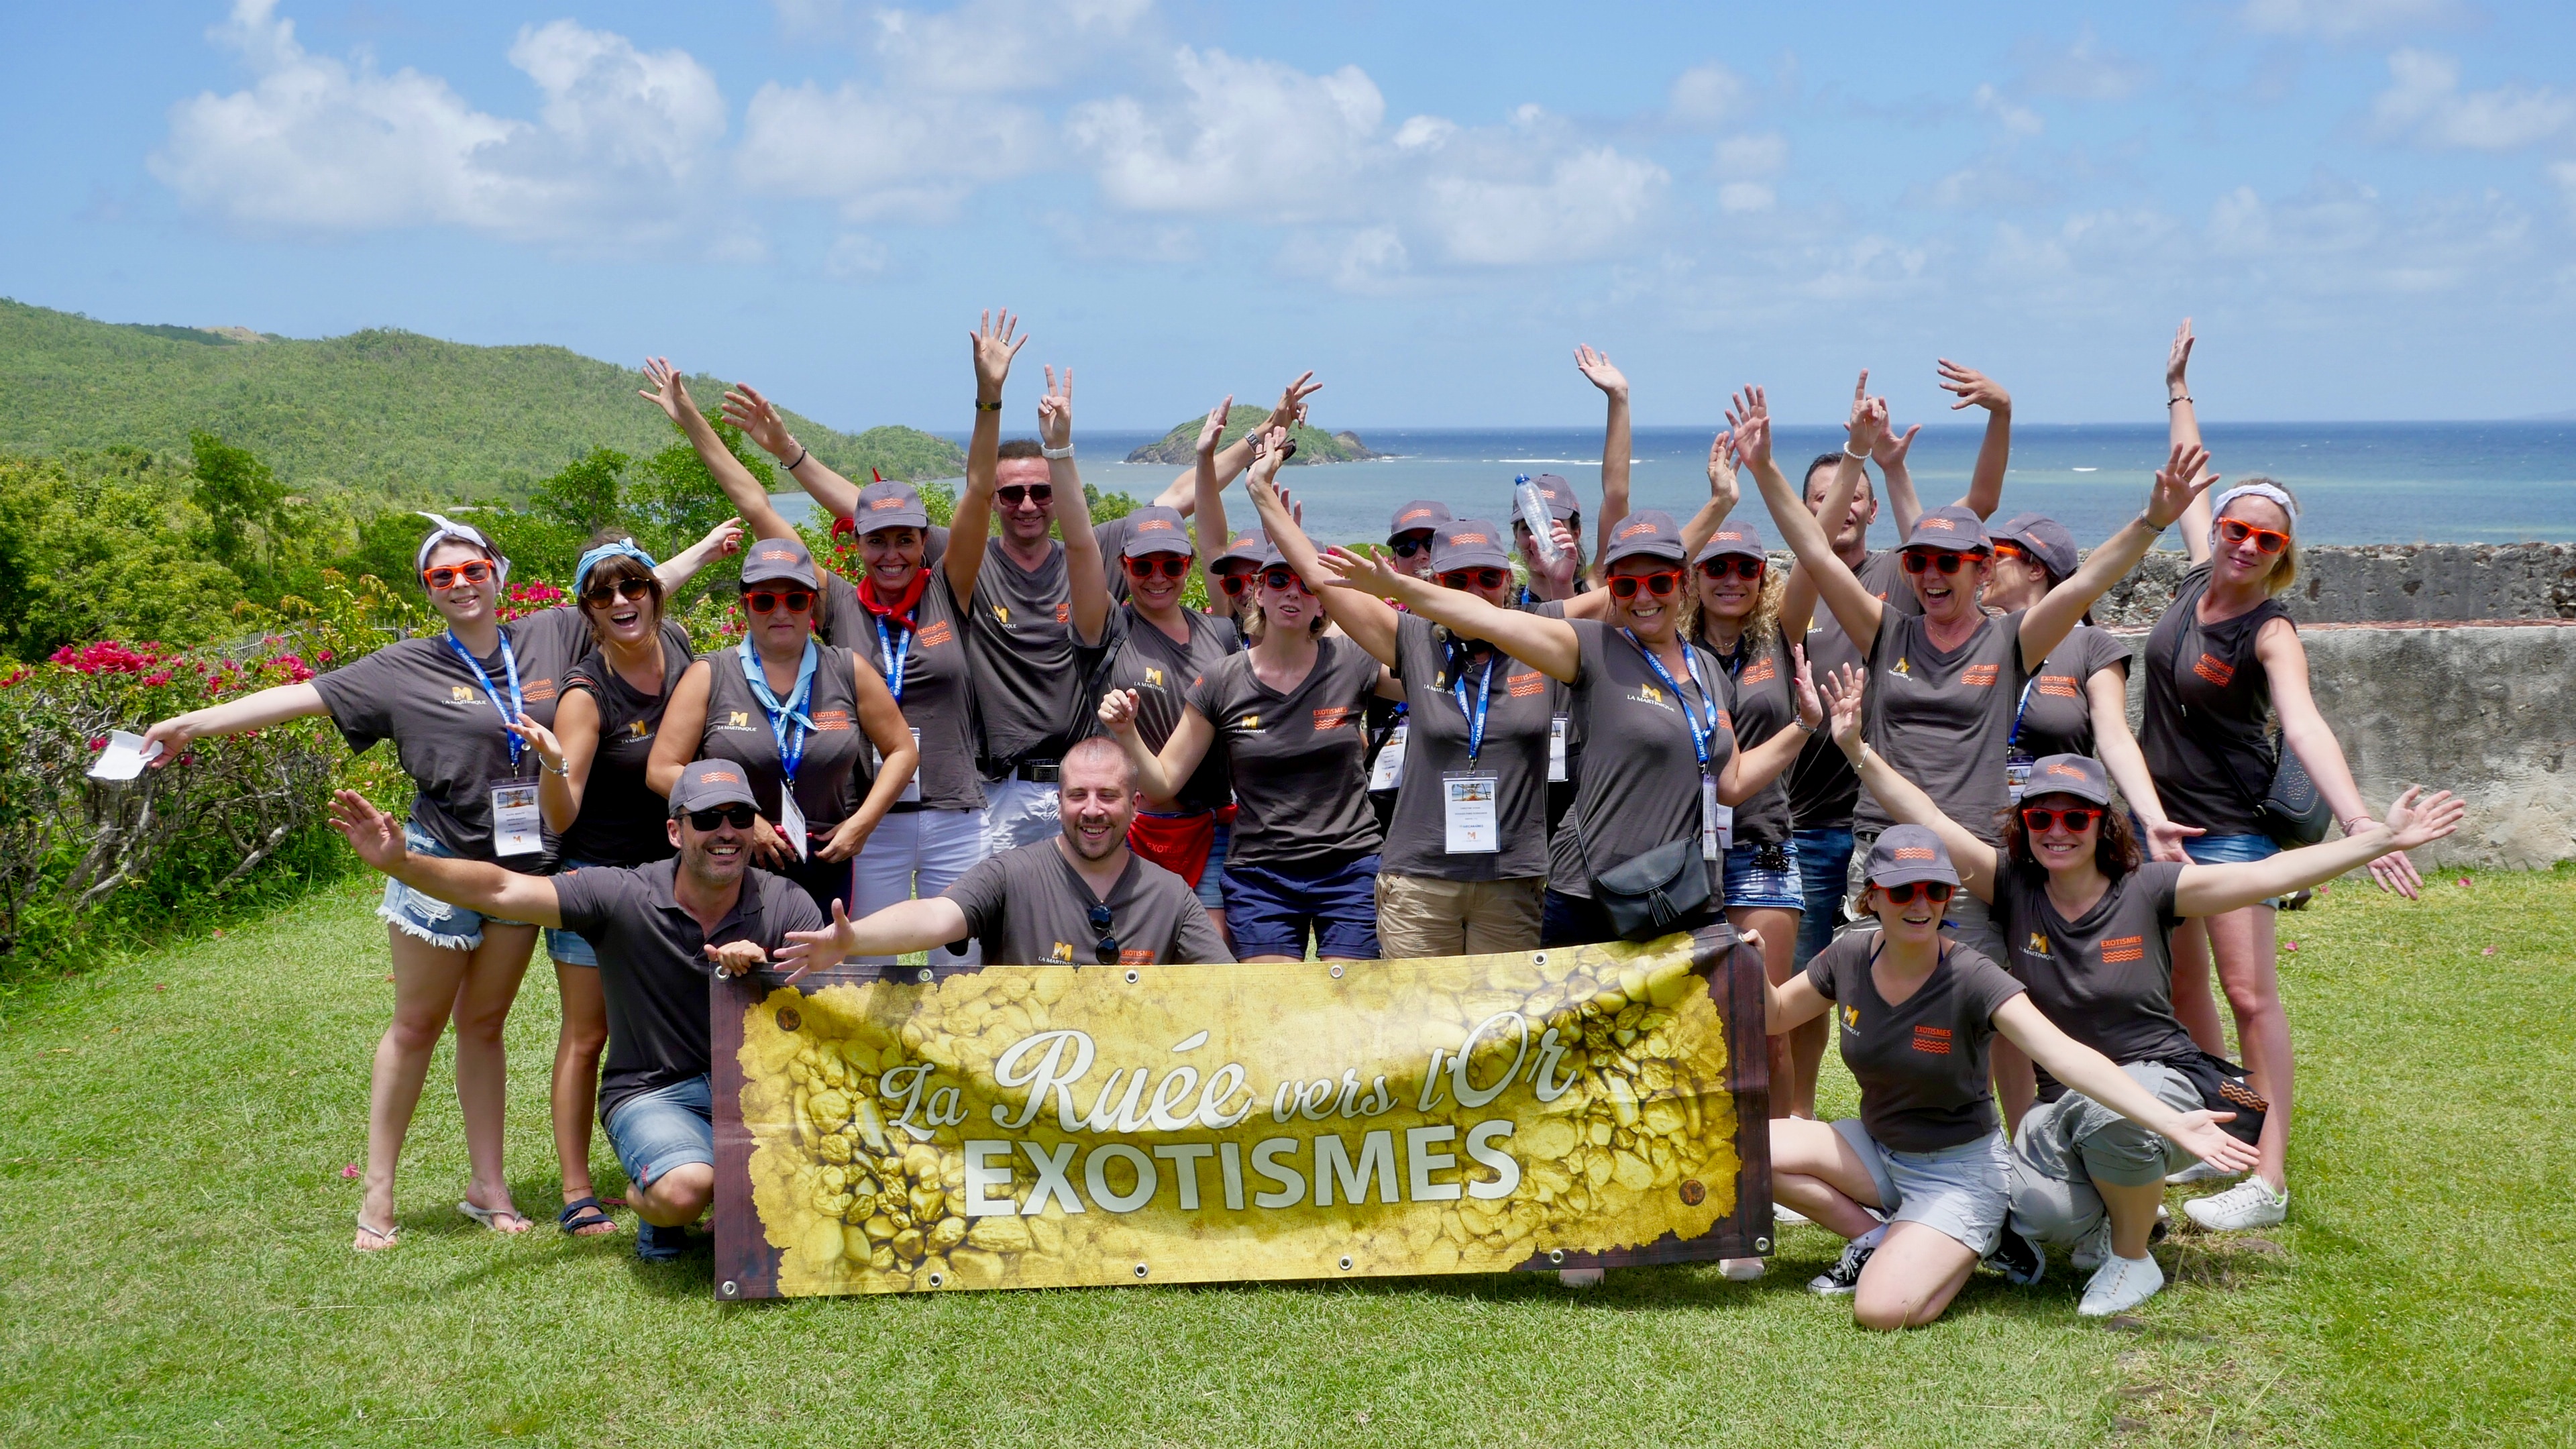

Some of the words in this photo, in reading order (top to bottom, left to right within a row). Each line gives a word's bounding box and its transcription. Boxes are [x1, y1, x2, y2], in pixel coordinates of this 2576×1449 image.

[2201, 653, 2235, 674] EXOTISMES
[1507, 672, 1542, 683] EXOTISMES
[2040, 676, 2076, 684] EXOTISMES
[1141, 682, 1168, 694] MARTINIQUE
[1636, 696, 1675, 712] MARTINIQUE
[812, 711, 847, 719] EXOTISMES
[2100, 936, 2142, 947] EXOTISMES
[1121, 949, 1154, 958] EXOTISMES
[2023, 949, 2055, 961] MARTINIQUE
[1915, 1026, 1951, 1036] EXOTISMES
[879, 1063, 968, 1140] La
[991, 1029, 1252, 1133] Ruée
[1273, 1068, 1398, 1123] vers
[1418, 1012, 1576, 1112] l'Or
[965, 1120, 1520, 1216] EXOTISMES
